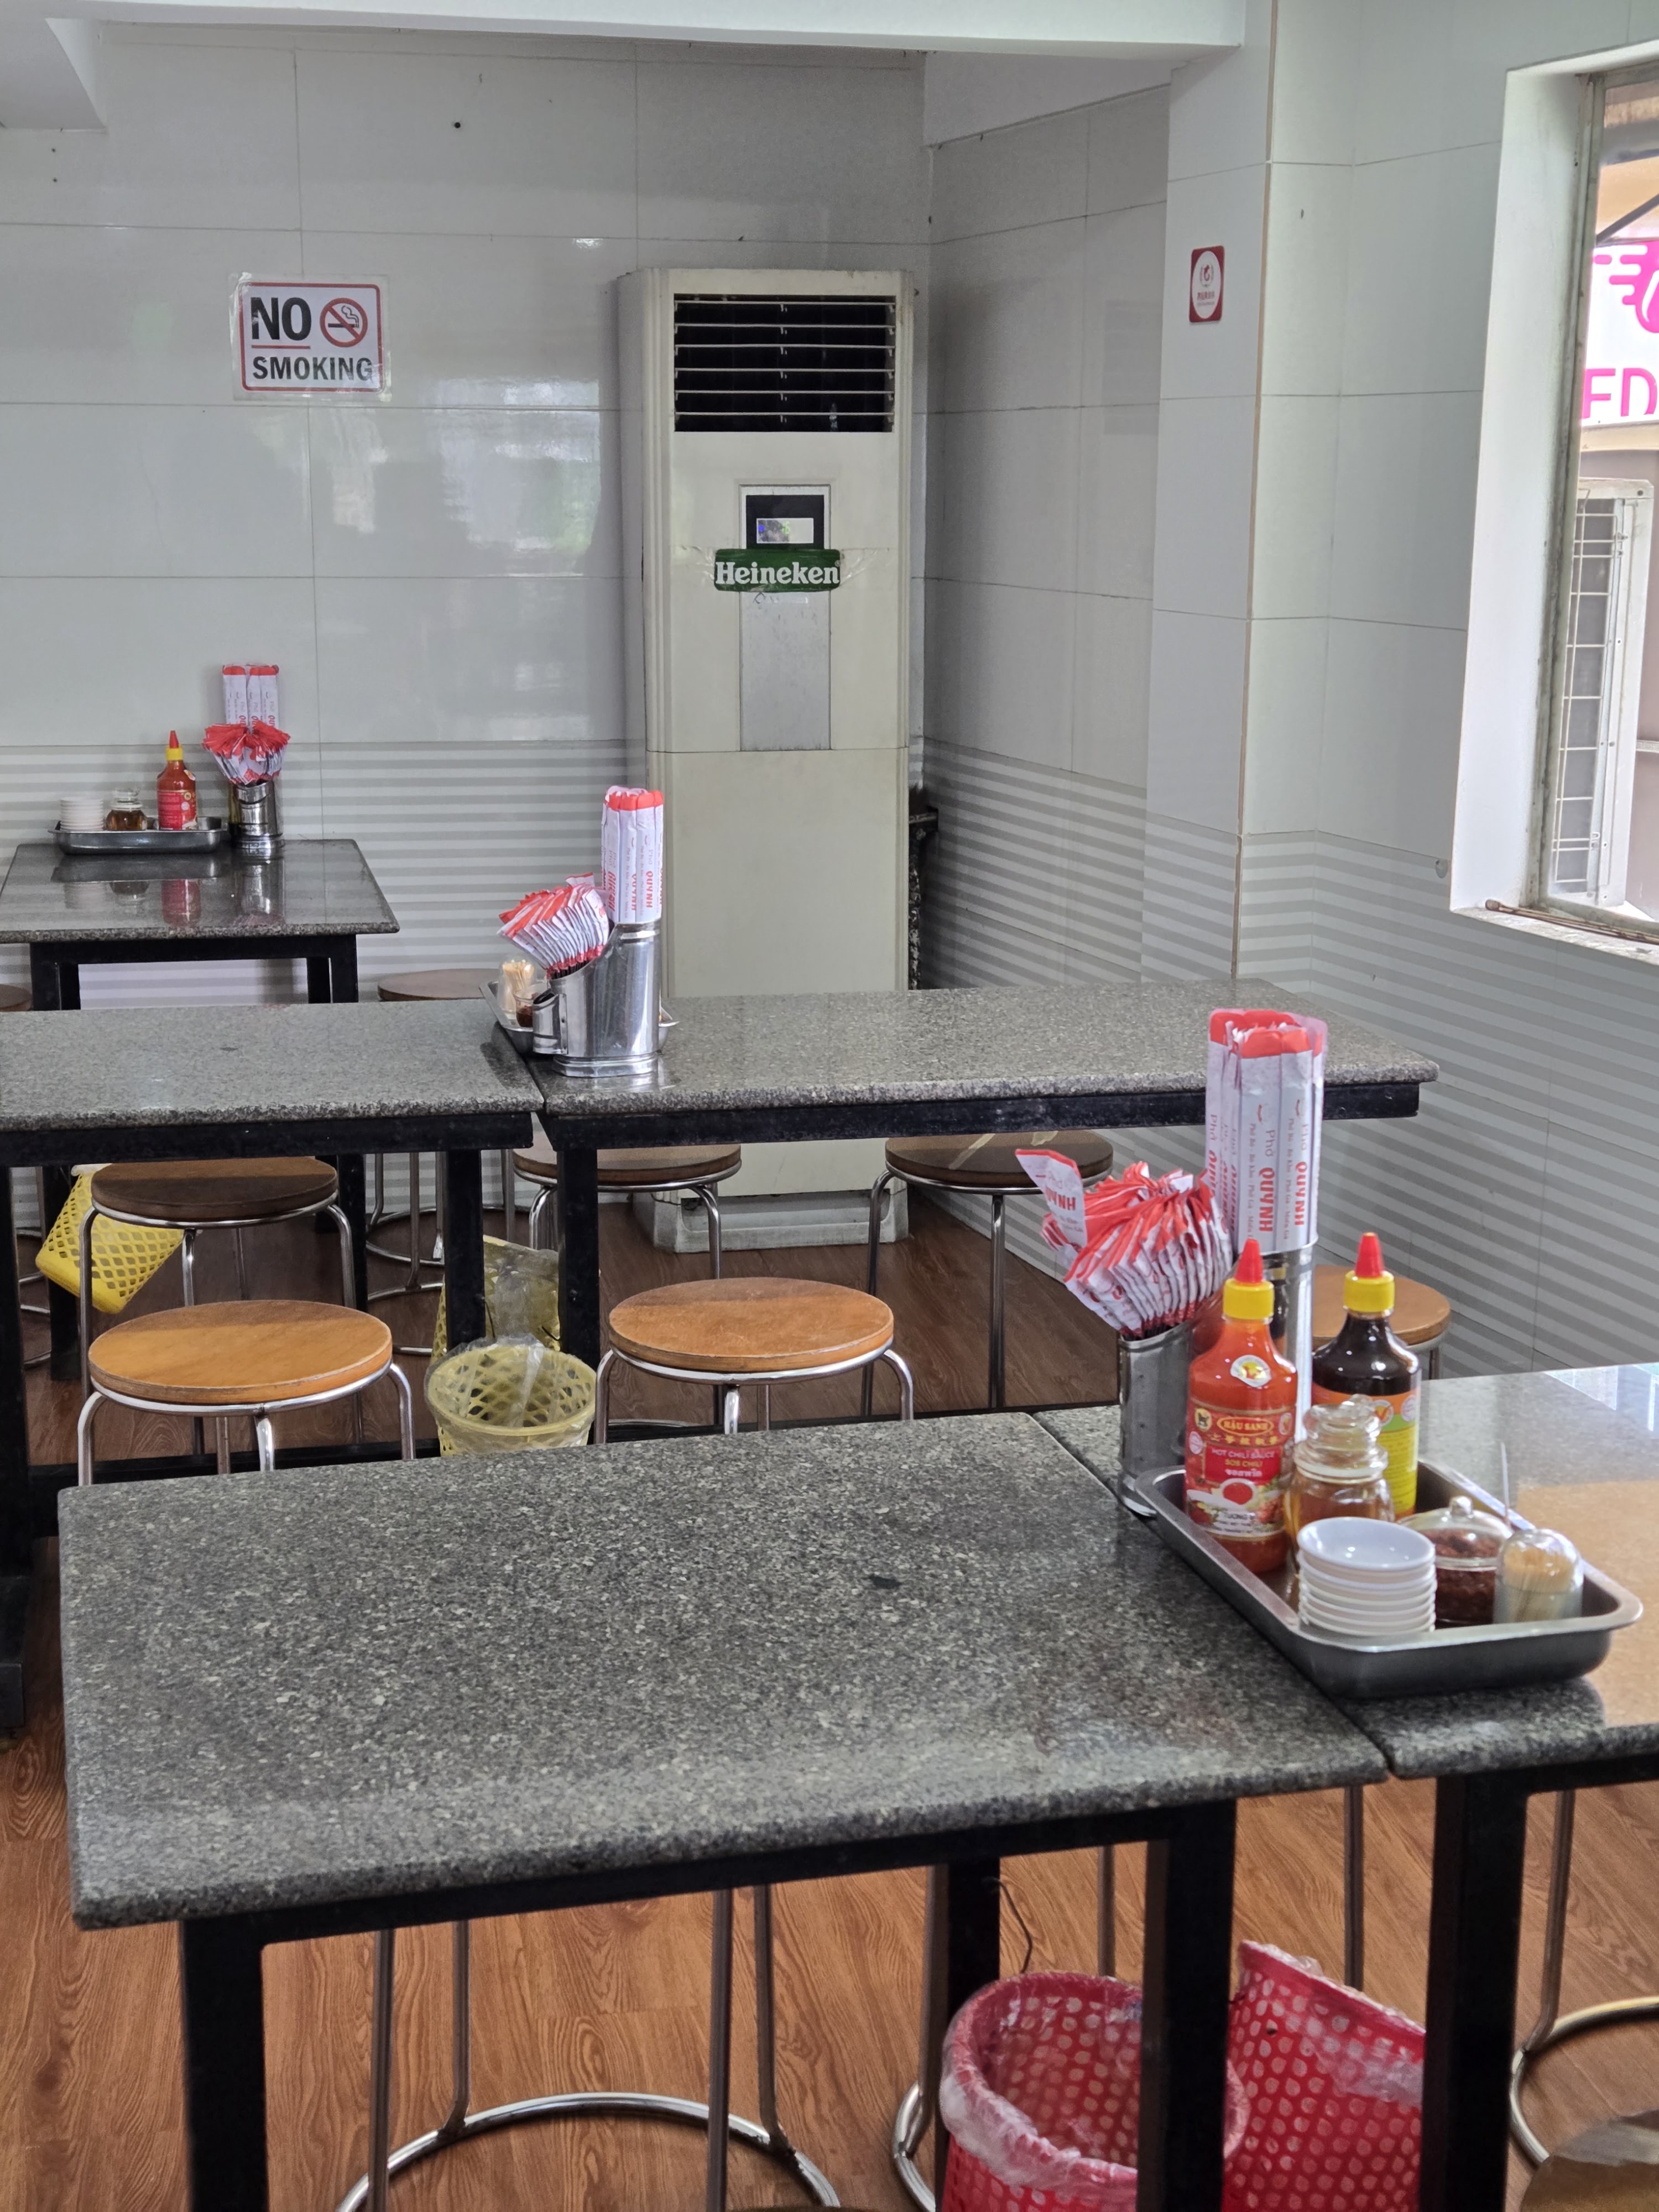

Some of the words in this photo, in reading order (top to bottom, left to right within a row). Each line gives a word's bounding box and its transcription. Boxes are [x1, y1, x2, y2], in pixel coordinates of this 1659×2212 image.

[251, 297, 311, 341] NO
[253, 356, 373, 381] SMOKING
[716, 561, 839, 584] Heineken
